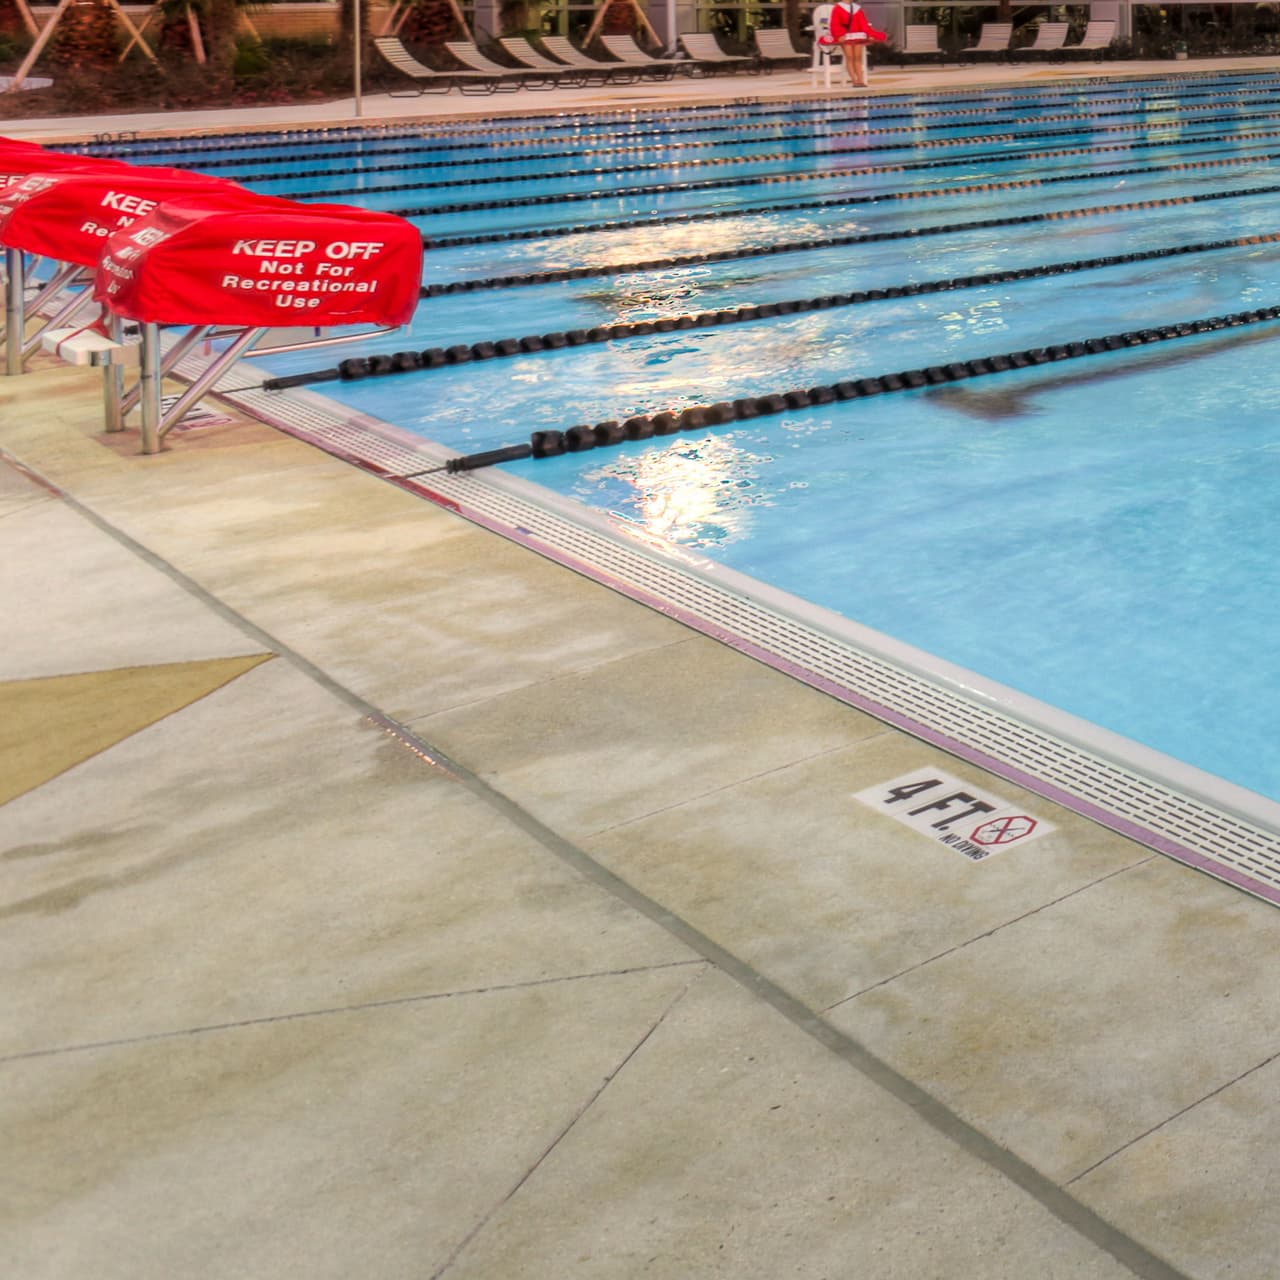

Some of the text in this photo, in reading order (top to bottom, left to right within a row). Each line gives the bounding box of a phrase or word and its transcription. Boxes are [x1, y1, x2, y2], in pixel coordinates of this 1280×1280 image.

[101, 191, 157, 216] KEE
[232, 240, 384, 260] KEEP OFF
[260, 260, 354, 277] Not For
[222, 275, 377, 293] Recreational
[275, 294, 320, 308] Use
[883, 779, 944, 804] 4
